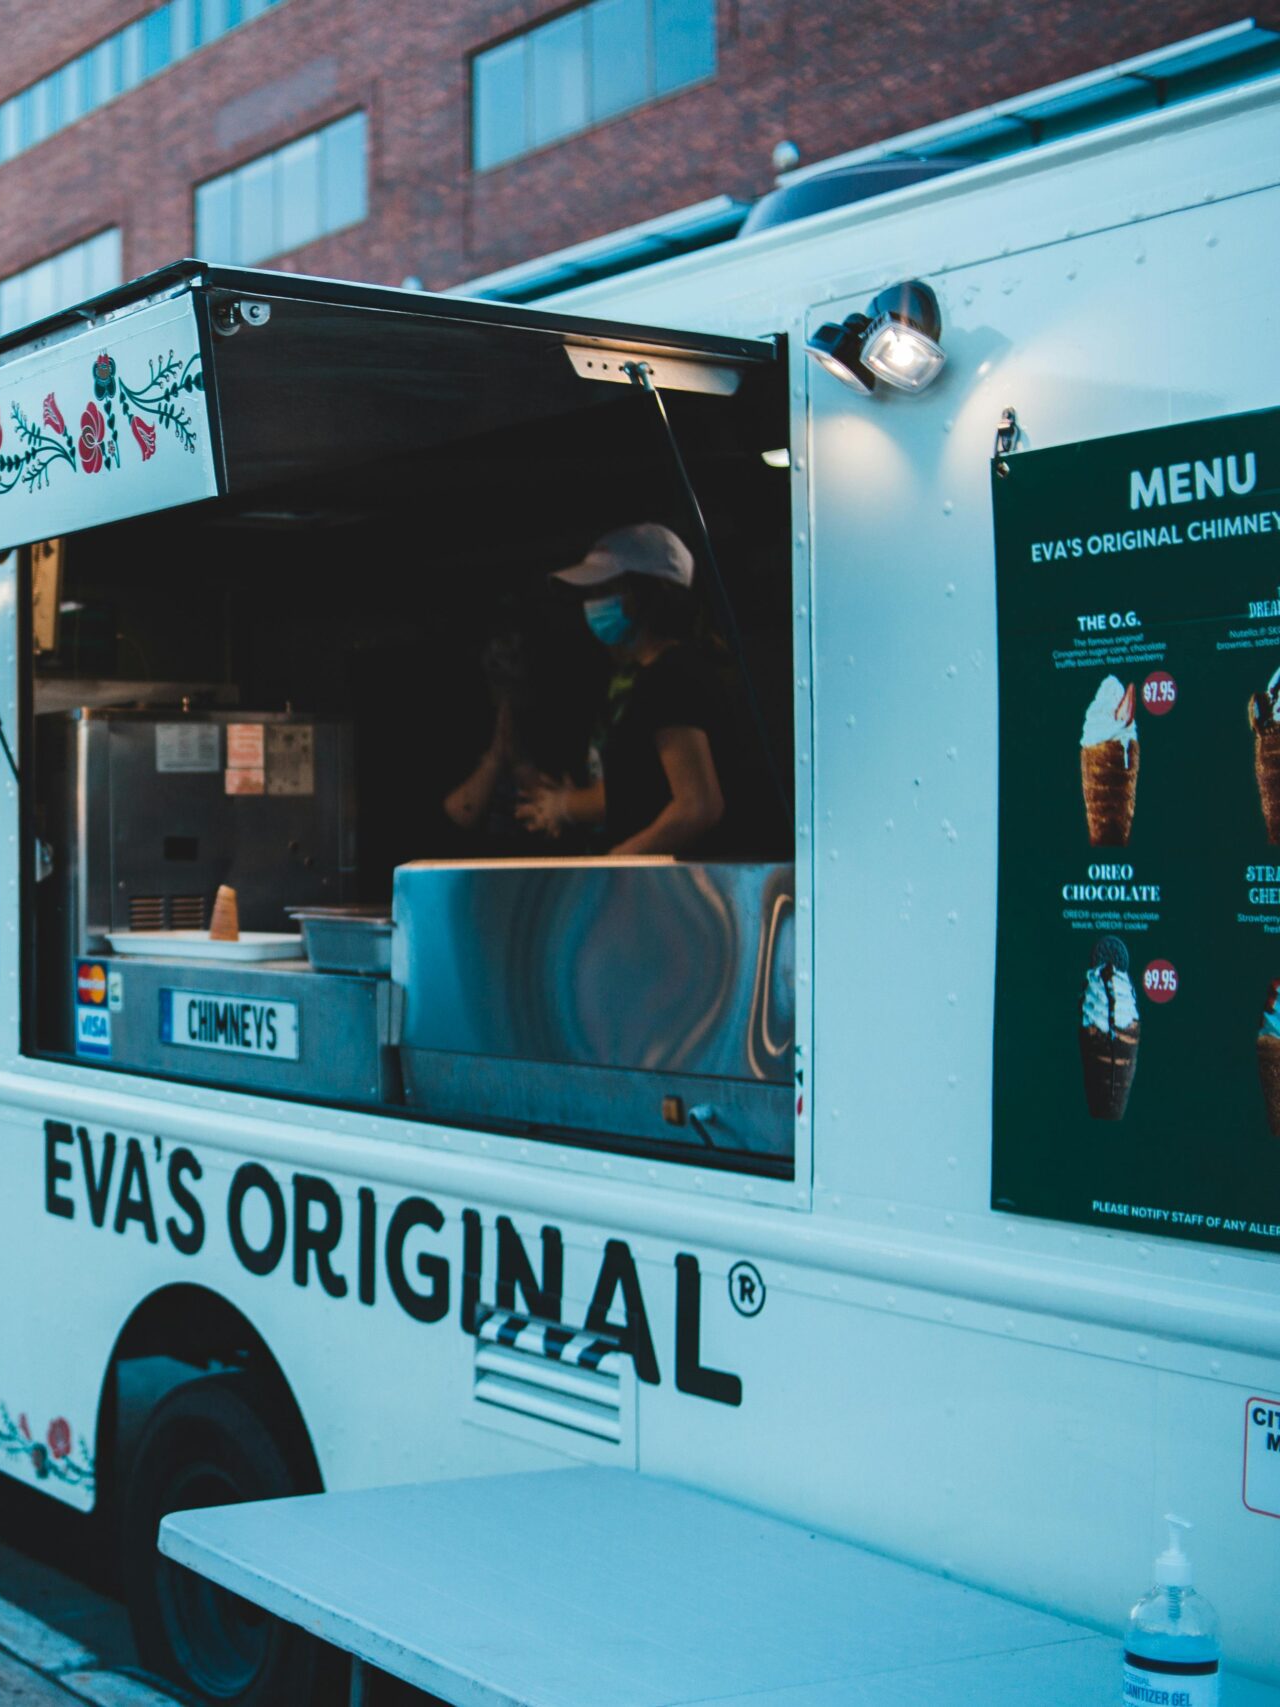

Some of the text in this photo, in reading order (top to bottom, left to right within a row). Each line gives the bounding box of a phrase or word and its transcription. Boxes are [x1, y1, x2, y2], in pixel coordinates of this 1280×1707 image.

[1130, 452, 1257, 510] MENU
[1031, 537, 1083, 562] EVA'S
[1087, 524, 1183, 555] ORIGINAL
[1248, 600, 1280, 618] DREA
[1077, 611, 1142, 632] THE O.G.
[1143, 681, 1176, 702] $7.95
[1088, 863, 1134, 881] OREO
[1062, 884, 1161, 902] CHOCOLATE
[1144, 969, 1177, 991] $9.95
[82, 1015, 108, 1038] VISA
[187, 999, 277, 1051] CHIMNEYS
[43, 1118, 205, 1256] EVA'S
[1092, 1200, 1129, 1216] PLEASE
[1131, 1206, 1169, 1221] NOTIFY
[1171, 1212, 1204, 1226] STAFF
[1206, 1216, 1221, 1228] OF
[1223, 1218, 1247, 1231] ANY
[1171, 1692, 1193, 1707] GEL
